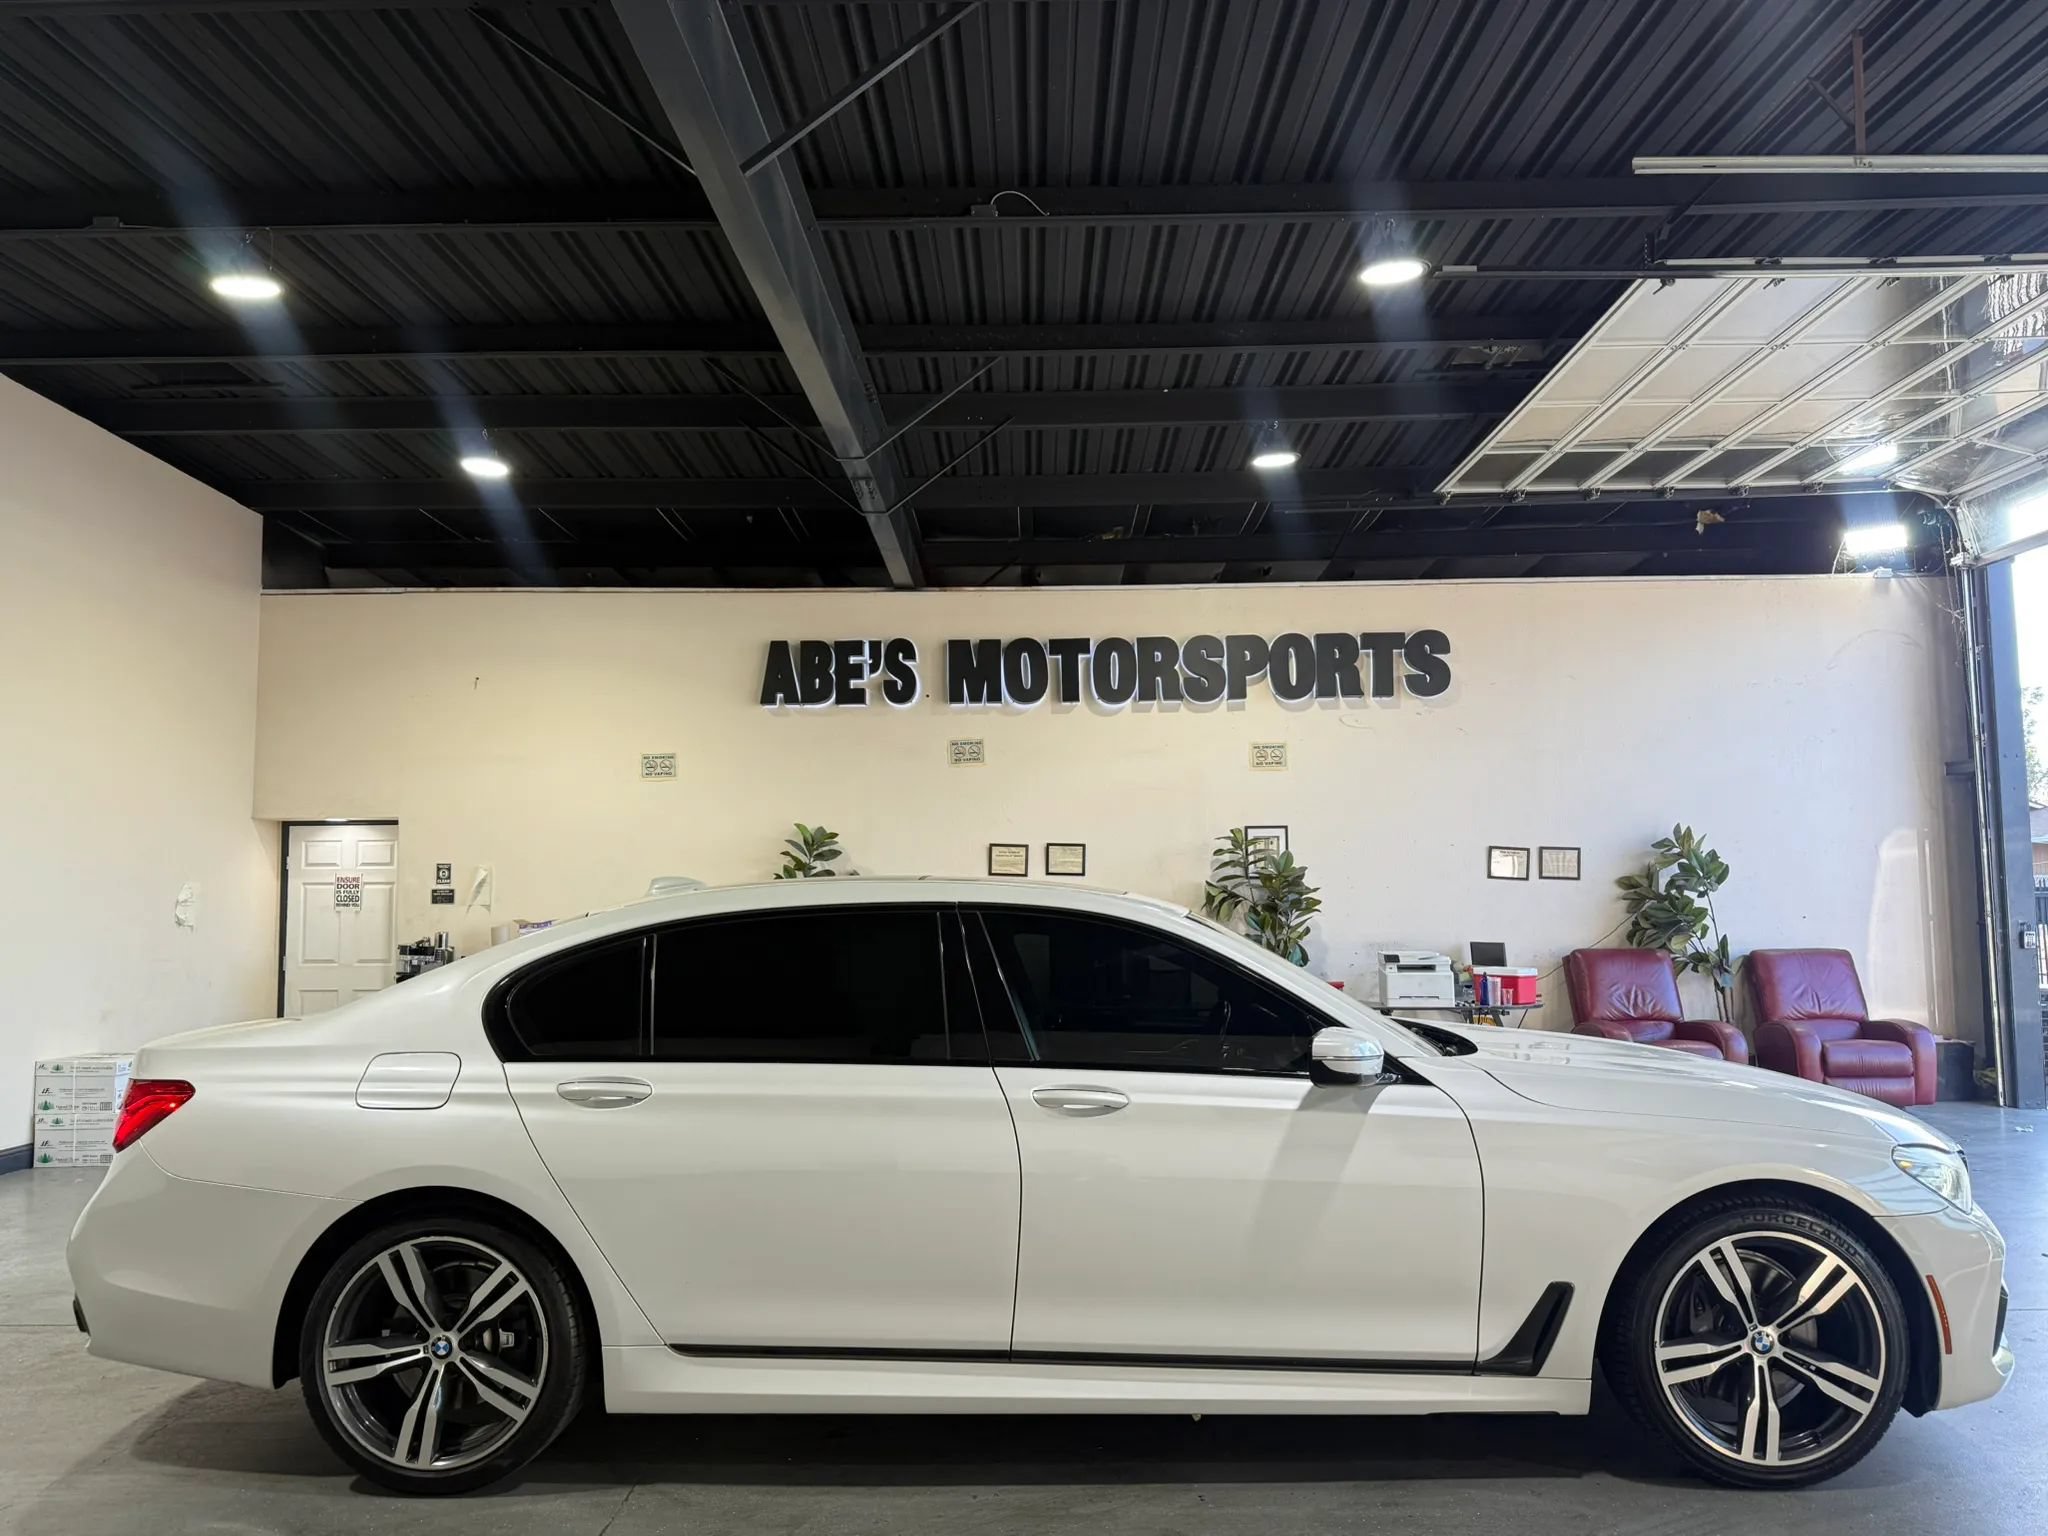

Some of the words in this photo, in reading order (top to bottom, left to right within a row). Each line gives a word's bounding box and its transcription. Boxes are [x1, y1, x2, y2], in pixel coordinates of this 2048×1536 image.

[760, 638, 920, 706] ABE'S
[947, 629, 1452, 706] MOTORSPORTS
[335, 895, 360, 903] CLOSED
